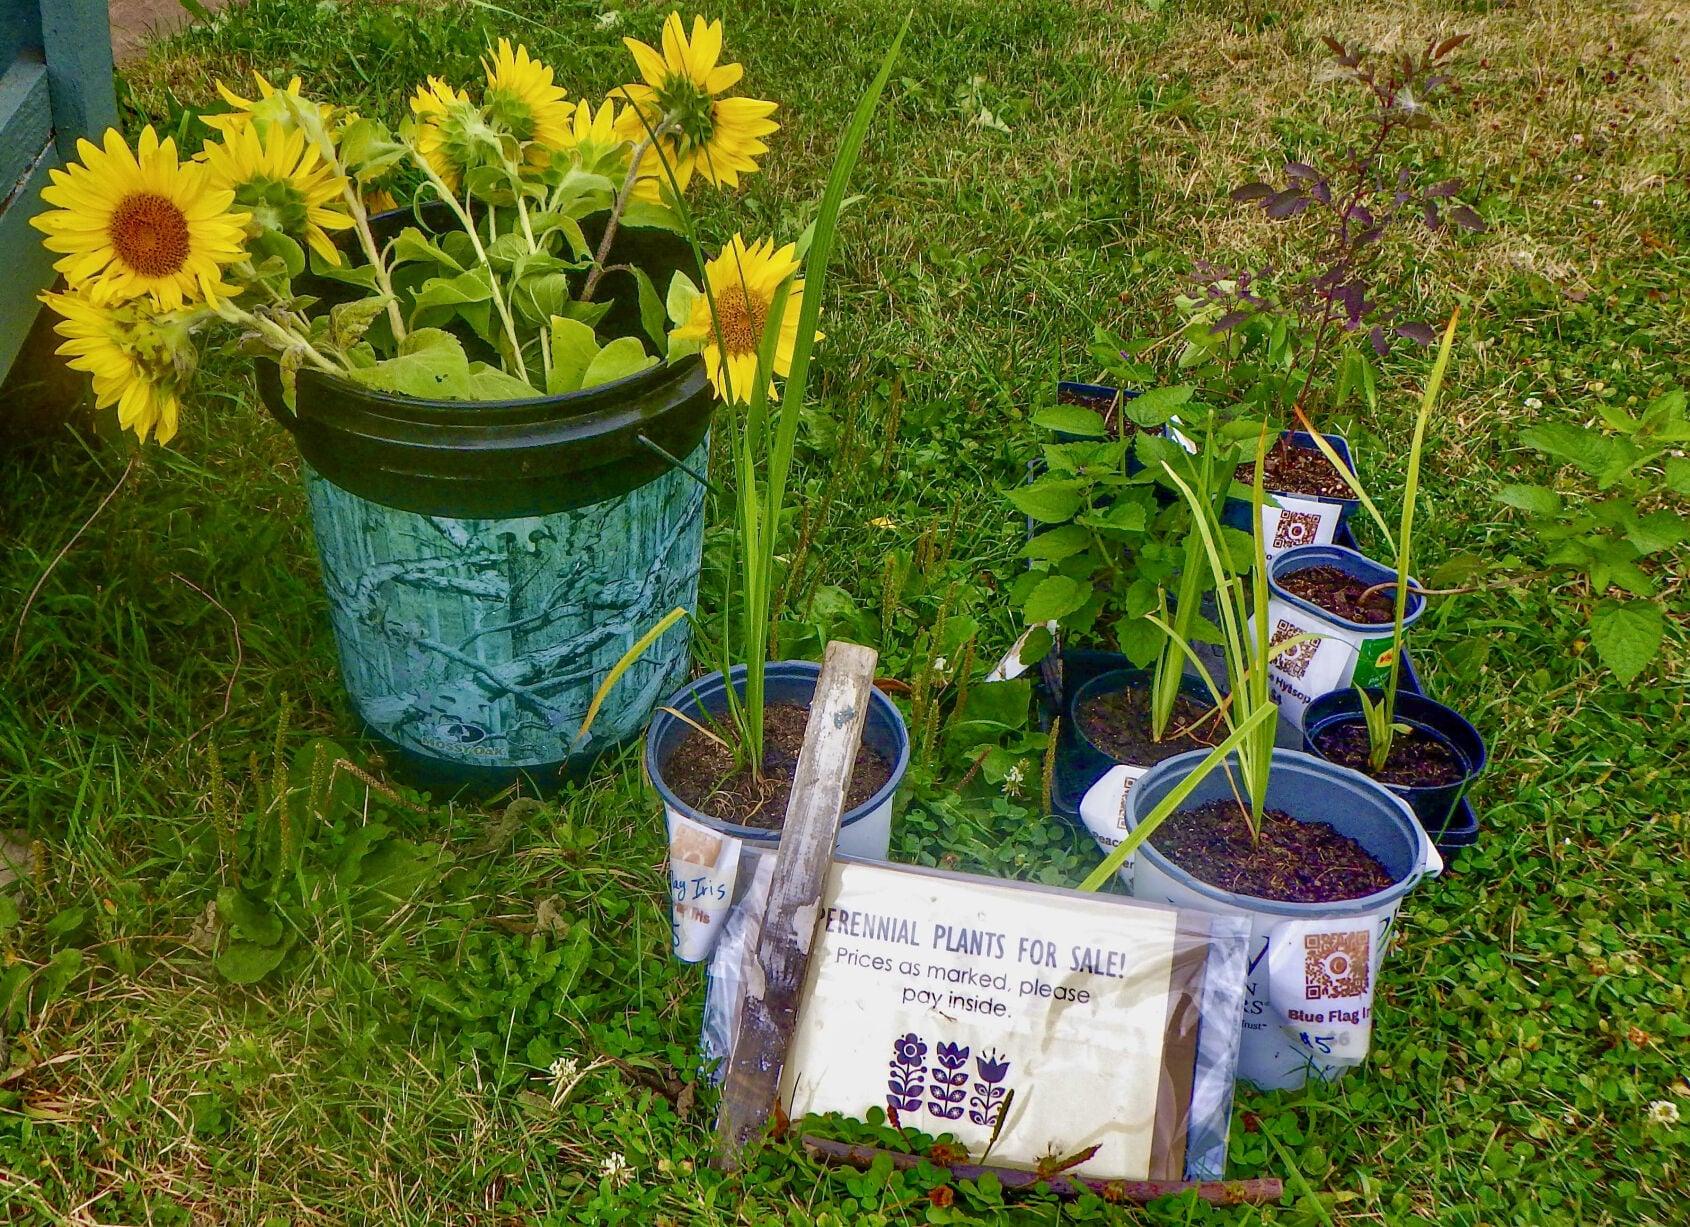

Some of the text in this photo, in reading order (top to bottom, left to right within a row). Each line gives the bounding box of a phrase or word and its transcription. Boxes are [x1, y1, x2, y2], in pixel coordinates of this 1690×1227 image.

[691, 876, 727, 900] Iris
[933, 924, 1006, 959] PLANTS
[1018, 937, 1057, 969] FOR
[1070, 945, 1126, 979] SALE!
[836, 946, 1090, 1004] Prices as marked, please
[902, 986, 1012, 1018] pay inside.
[1288, 1009, 1324, 1023] Blue
[1328, 1009, 1360, 1025] Flag
